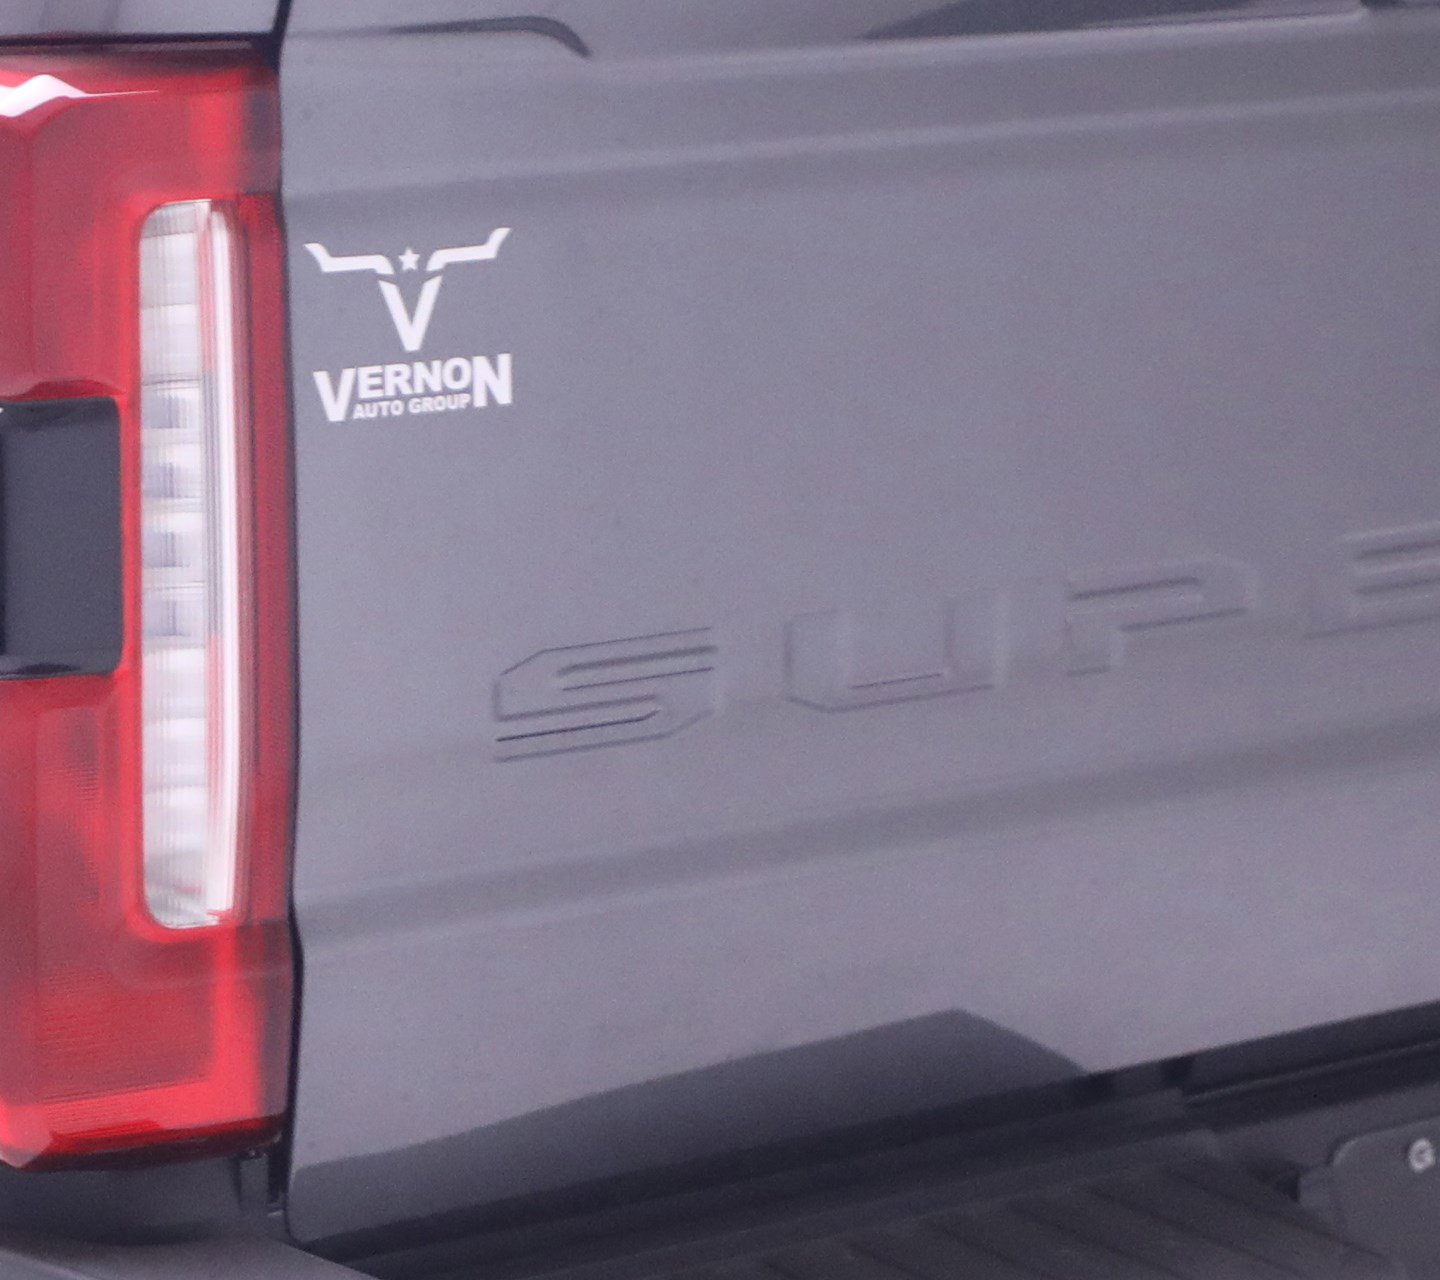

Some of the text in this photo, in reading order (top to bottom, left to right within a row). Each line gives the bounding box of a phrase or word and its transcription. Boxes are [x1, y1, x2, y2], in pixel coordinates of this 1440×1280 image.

[313, 353, 513, 422] VERNON
[352, 393, 472, 420] AUTO GROUP
